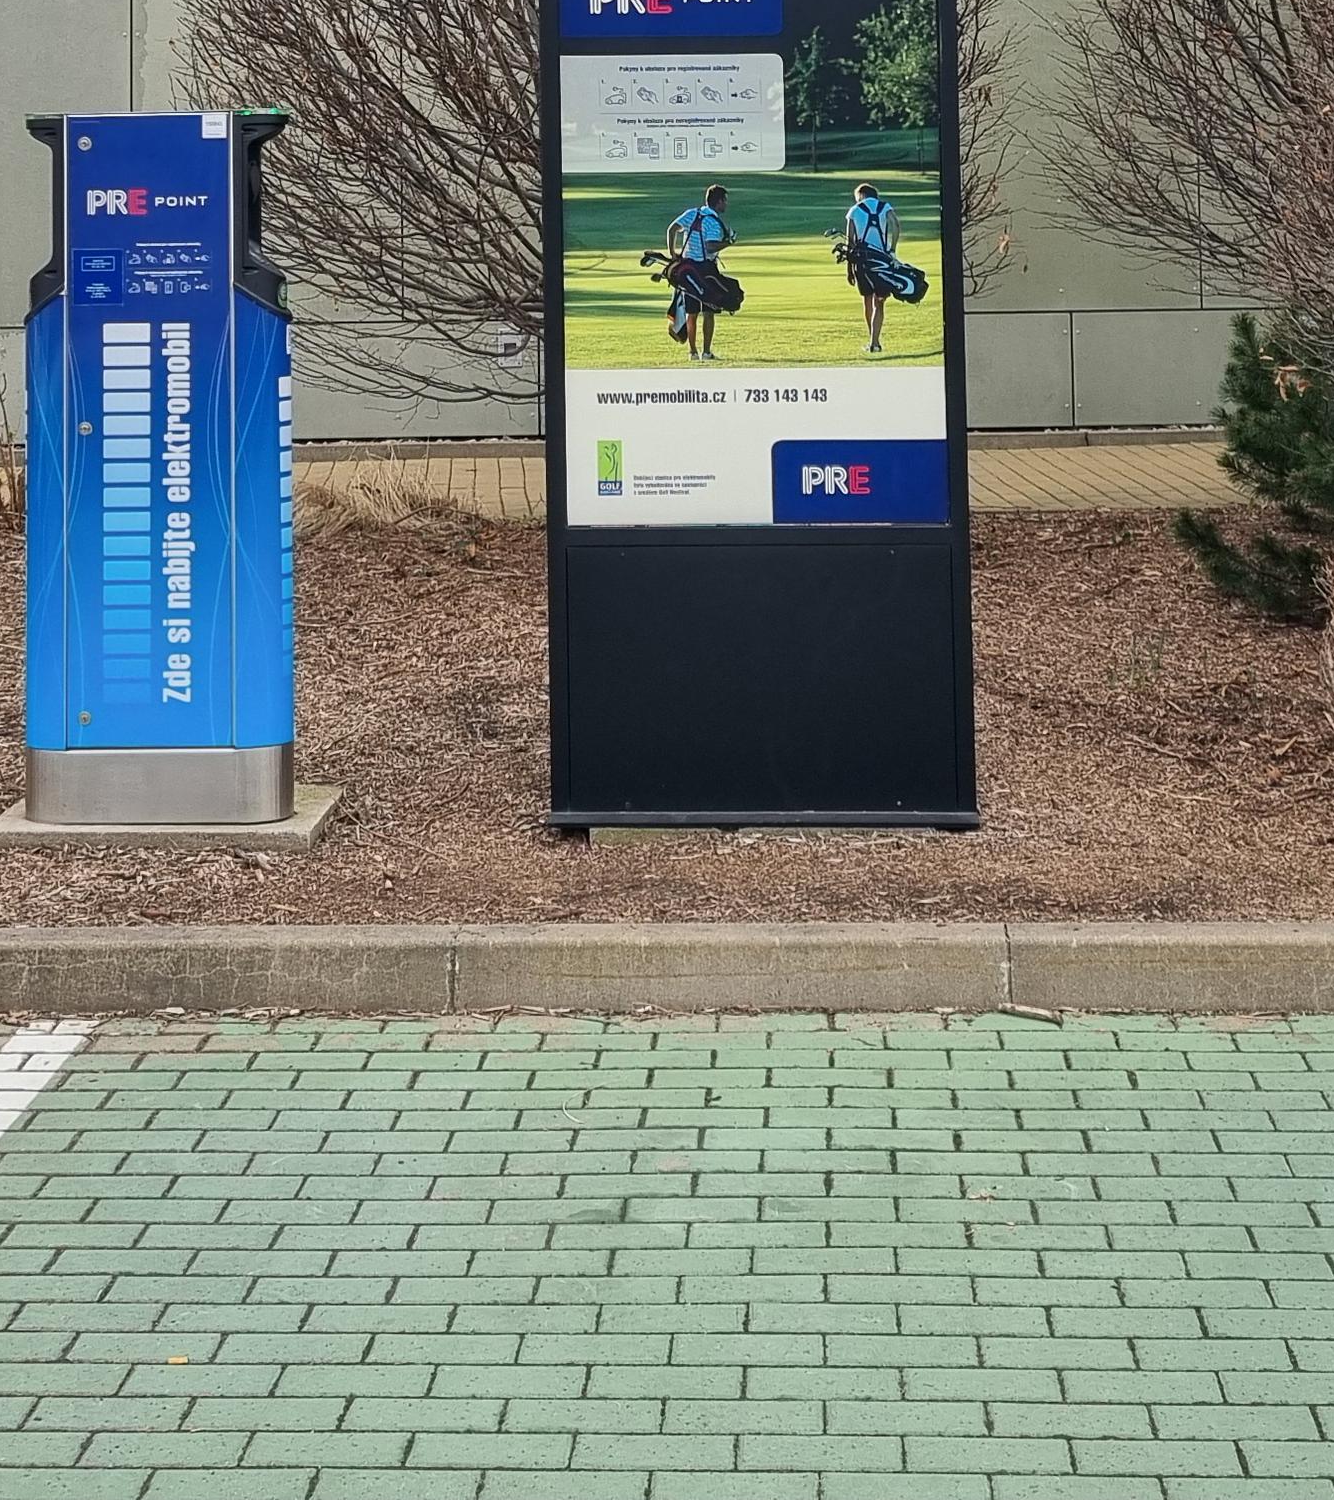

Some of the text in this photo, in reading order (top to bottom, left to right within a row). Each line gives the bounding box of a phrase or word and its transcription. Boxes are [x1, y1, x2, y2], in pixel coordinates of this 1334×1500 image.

[87, 189, 208, 216] PRE POINT
[597, 388, 828, 406] www.premobilita.cz 733 143 143
[600, 482, 620, 491] GOLF
[802, 465, 871, 495] PRE
[162, 322, 195, 703] Zde si nabijte elektromobil
